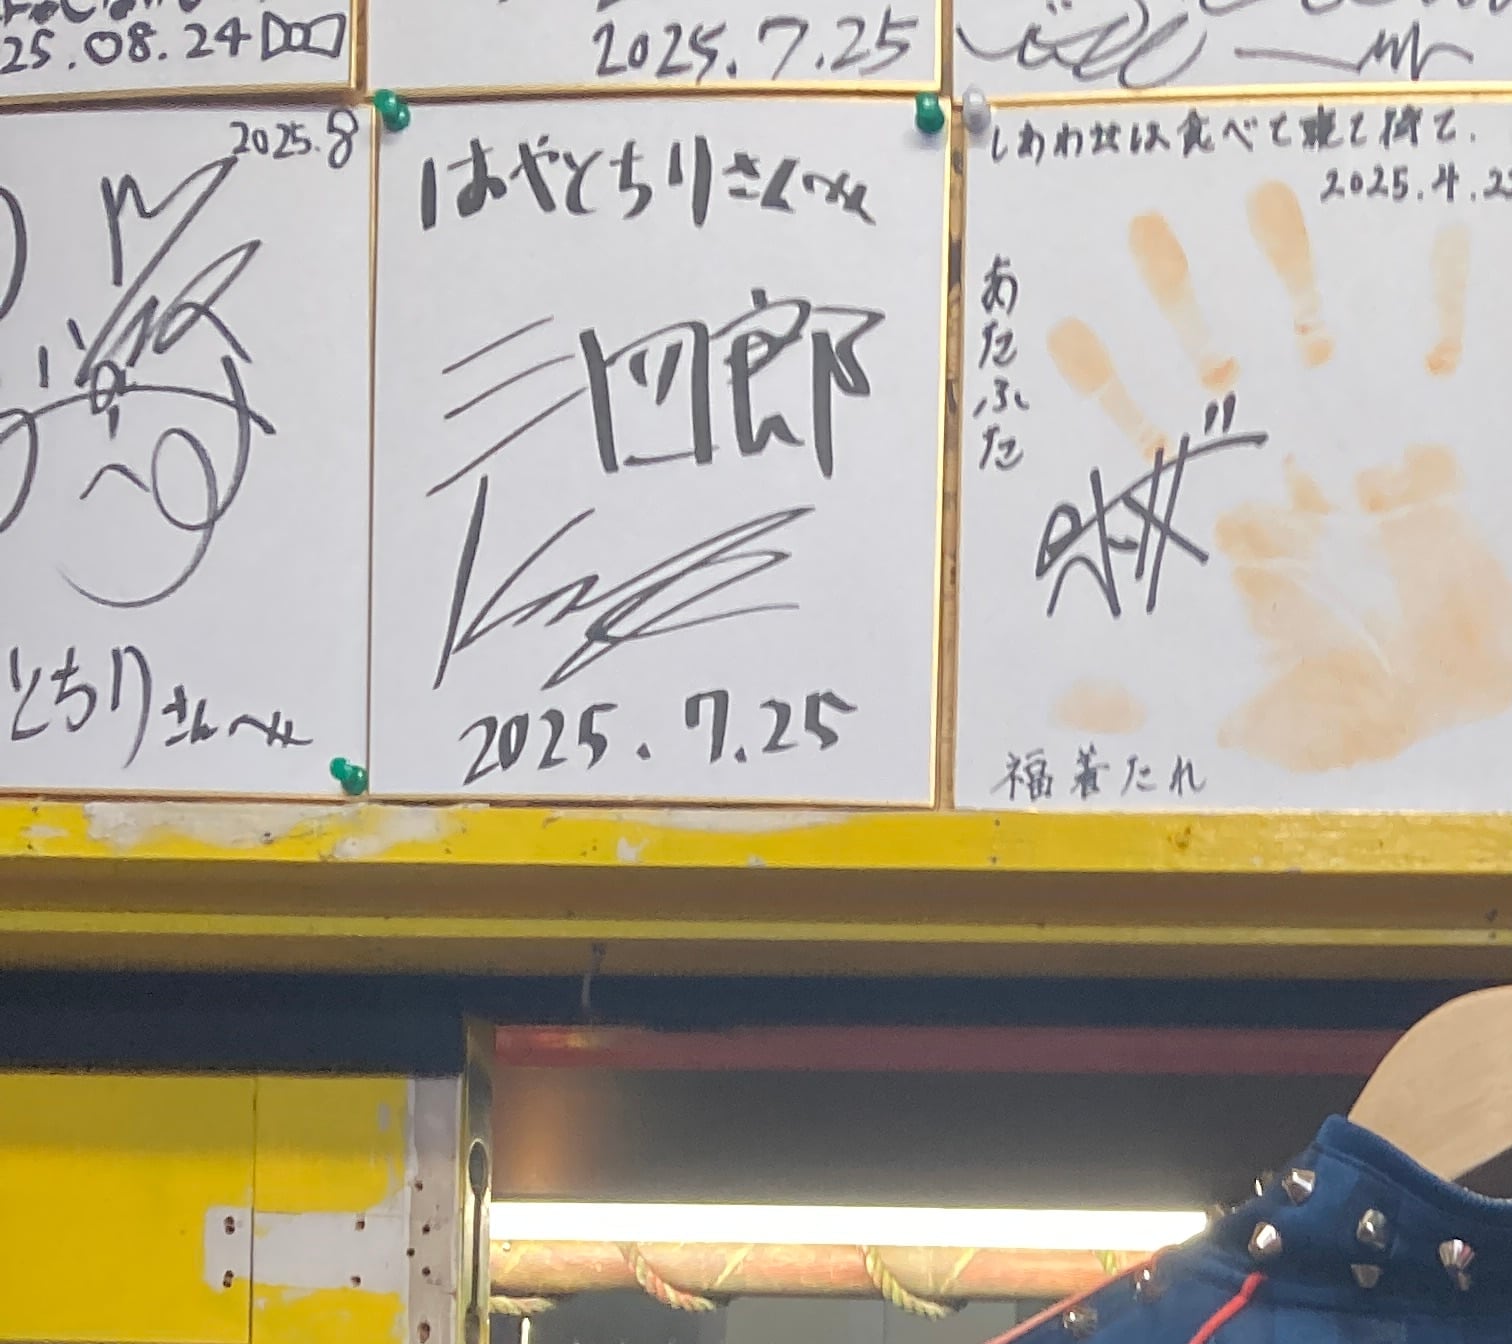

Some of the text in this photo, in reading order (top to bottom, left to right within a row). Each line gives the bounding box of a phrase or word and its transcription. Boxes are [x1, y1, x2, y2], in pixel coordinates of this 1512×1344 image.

[592, 5, 918, 85] 2025.7.25
[230, 108, 358, 168] 2025.8
[972, 253, 1030, 470] あたふた
[459, 689, 858, 786] 2025.7.25
